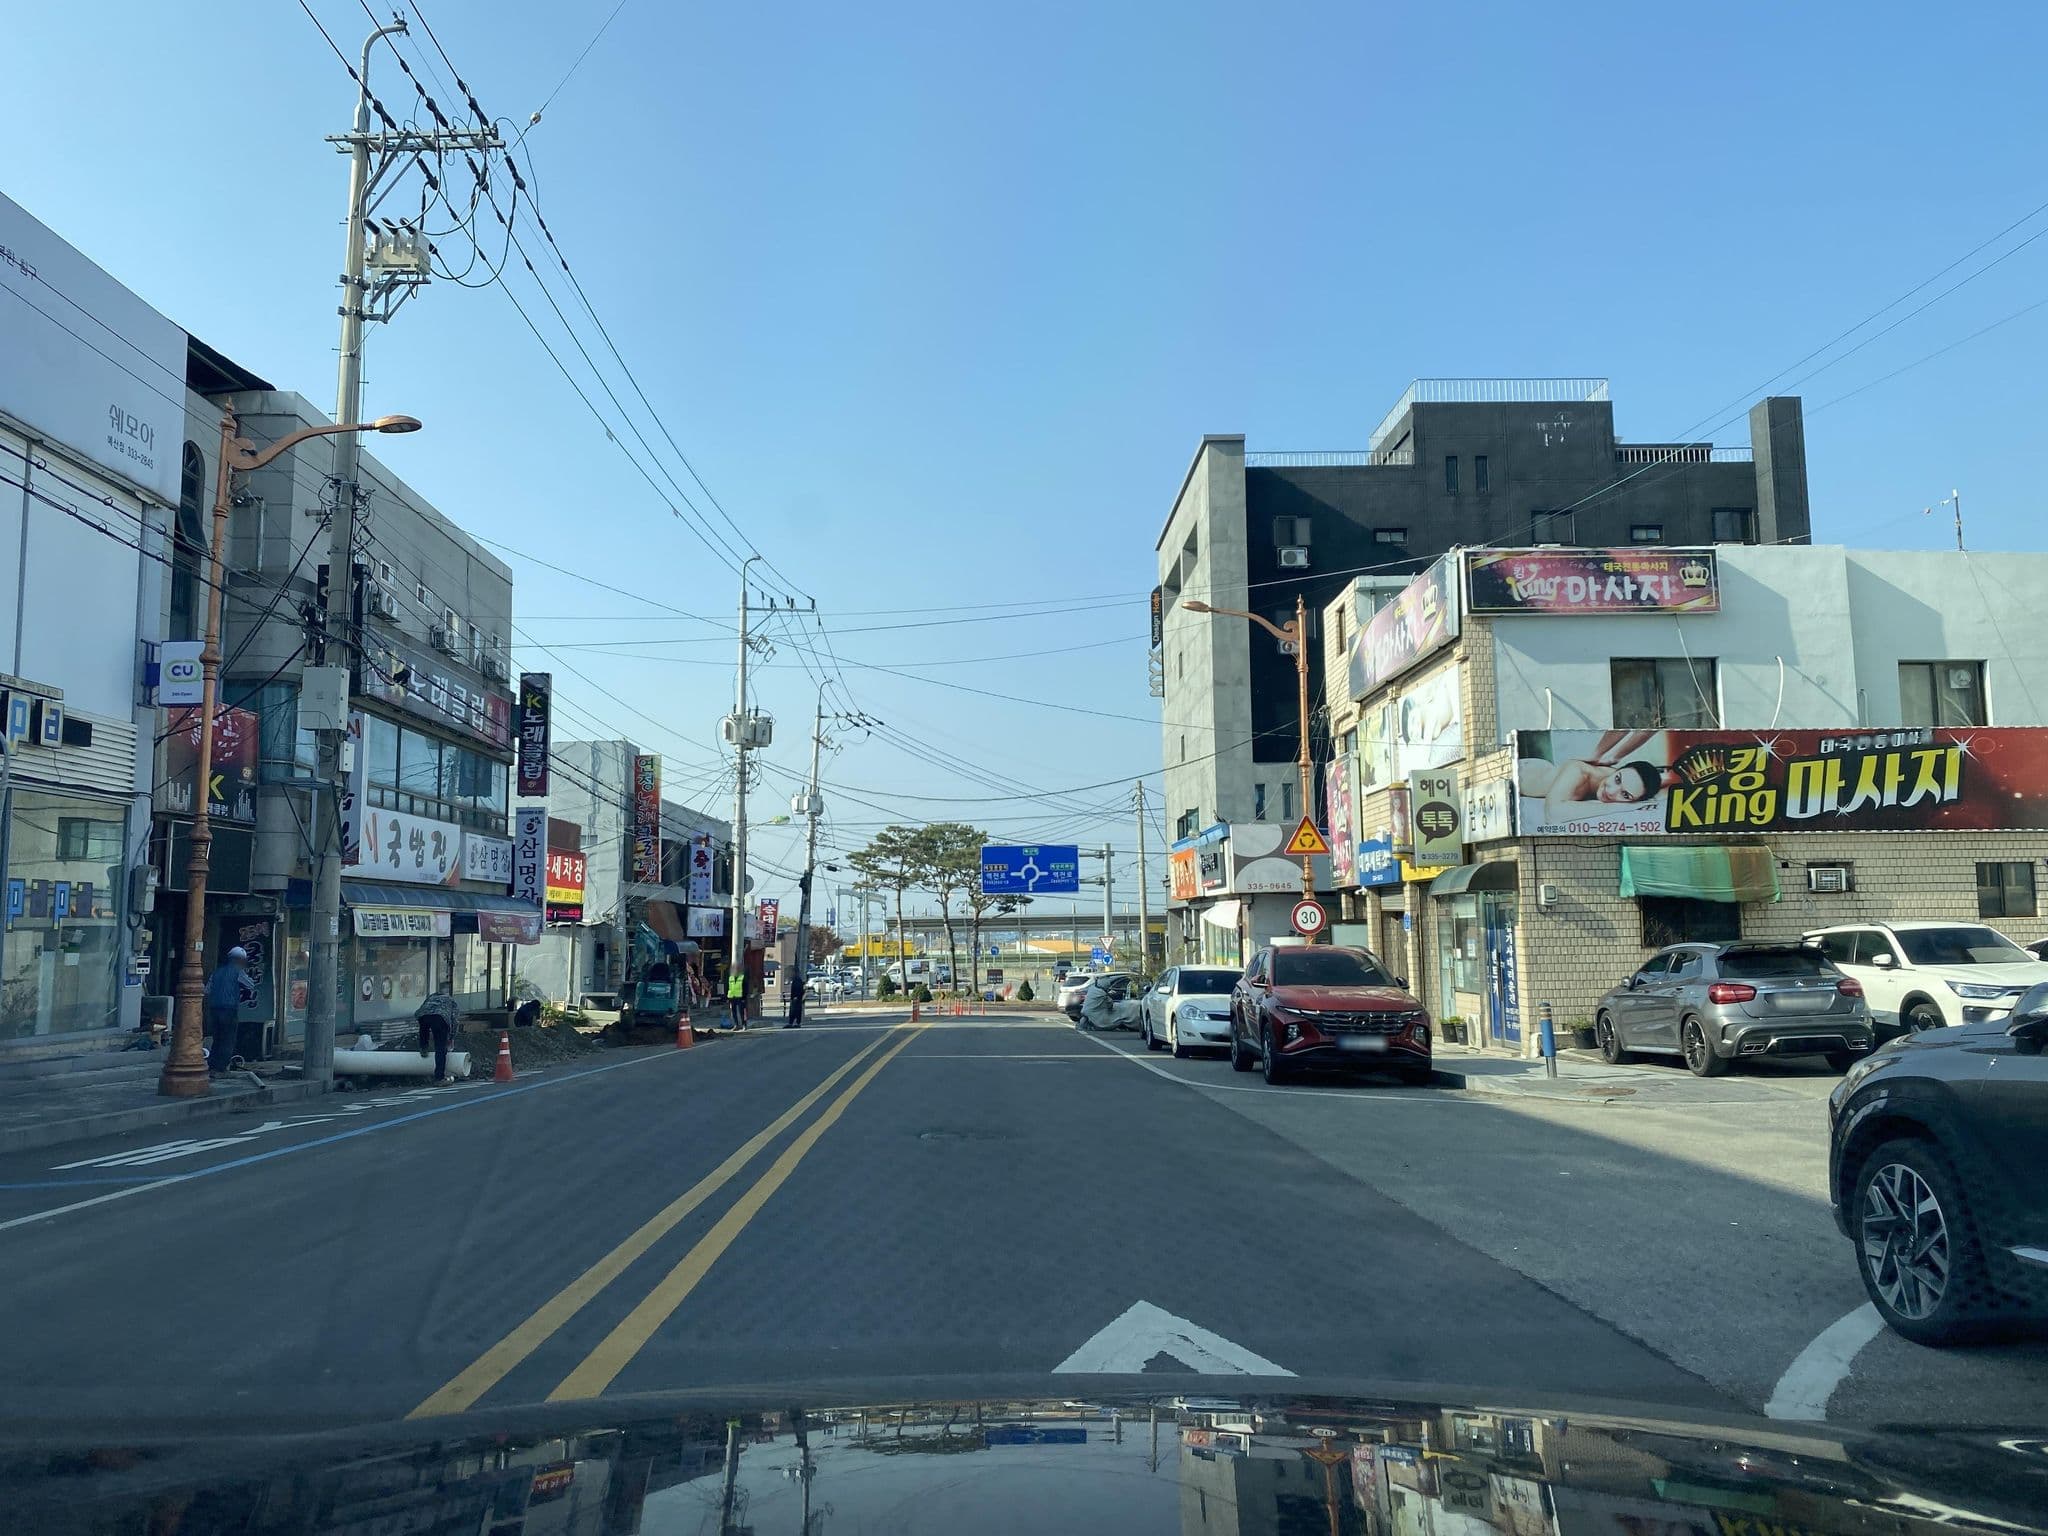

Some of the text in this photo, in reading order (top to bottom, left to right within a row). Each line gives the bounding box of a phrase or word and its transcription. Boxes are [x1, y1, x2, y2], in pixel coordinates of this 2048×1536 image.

[109, 404, 154, 451] 쉐모아
[1513, 566, 1525, 578] 킹
[1567, 575, 1674, 602] 마사지
[171, 665, 193, 676] CU
[1728, 748, 1769, 791] 킹
[1420, 779, 1451, 797] 헤어
[1670, 748, 1963, 829] King 마사지
[1422, 811, 1454, 831] 톡톡
[1468, 793, 1497, 832] 담쟁이
[1537, 822, 1661, 833] 예약문의 010-8274-1502
[386, 818, 447, 874] 국밥집
[546, 853, 584, 883] 세차장
[1248, 882, 1293, 890] 335-0645
[1301, 911, 1317, 924] 30
